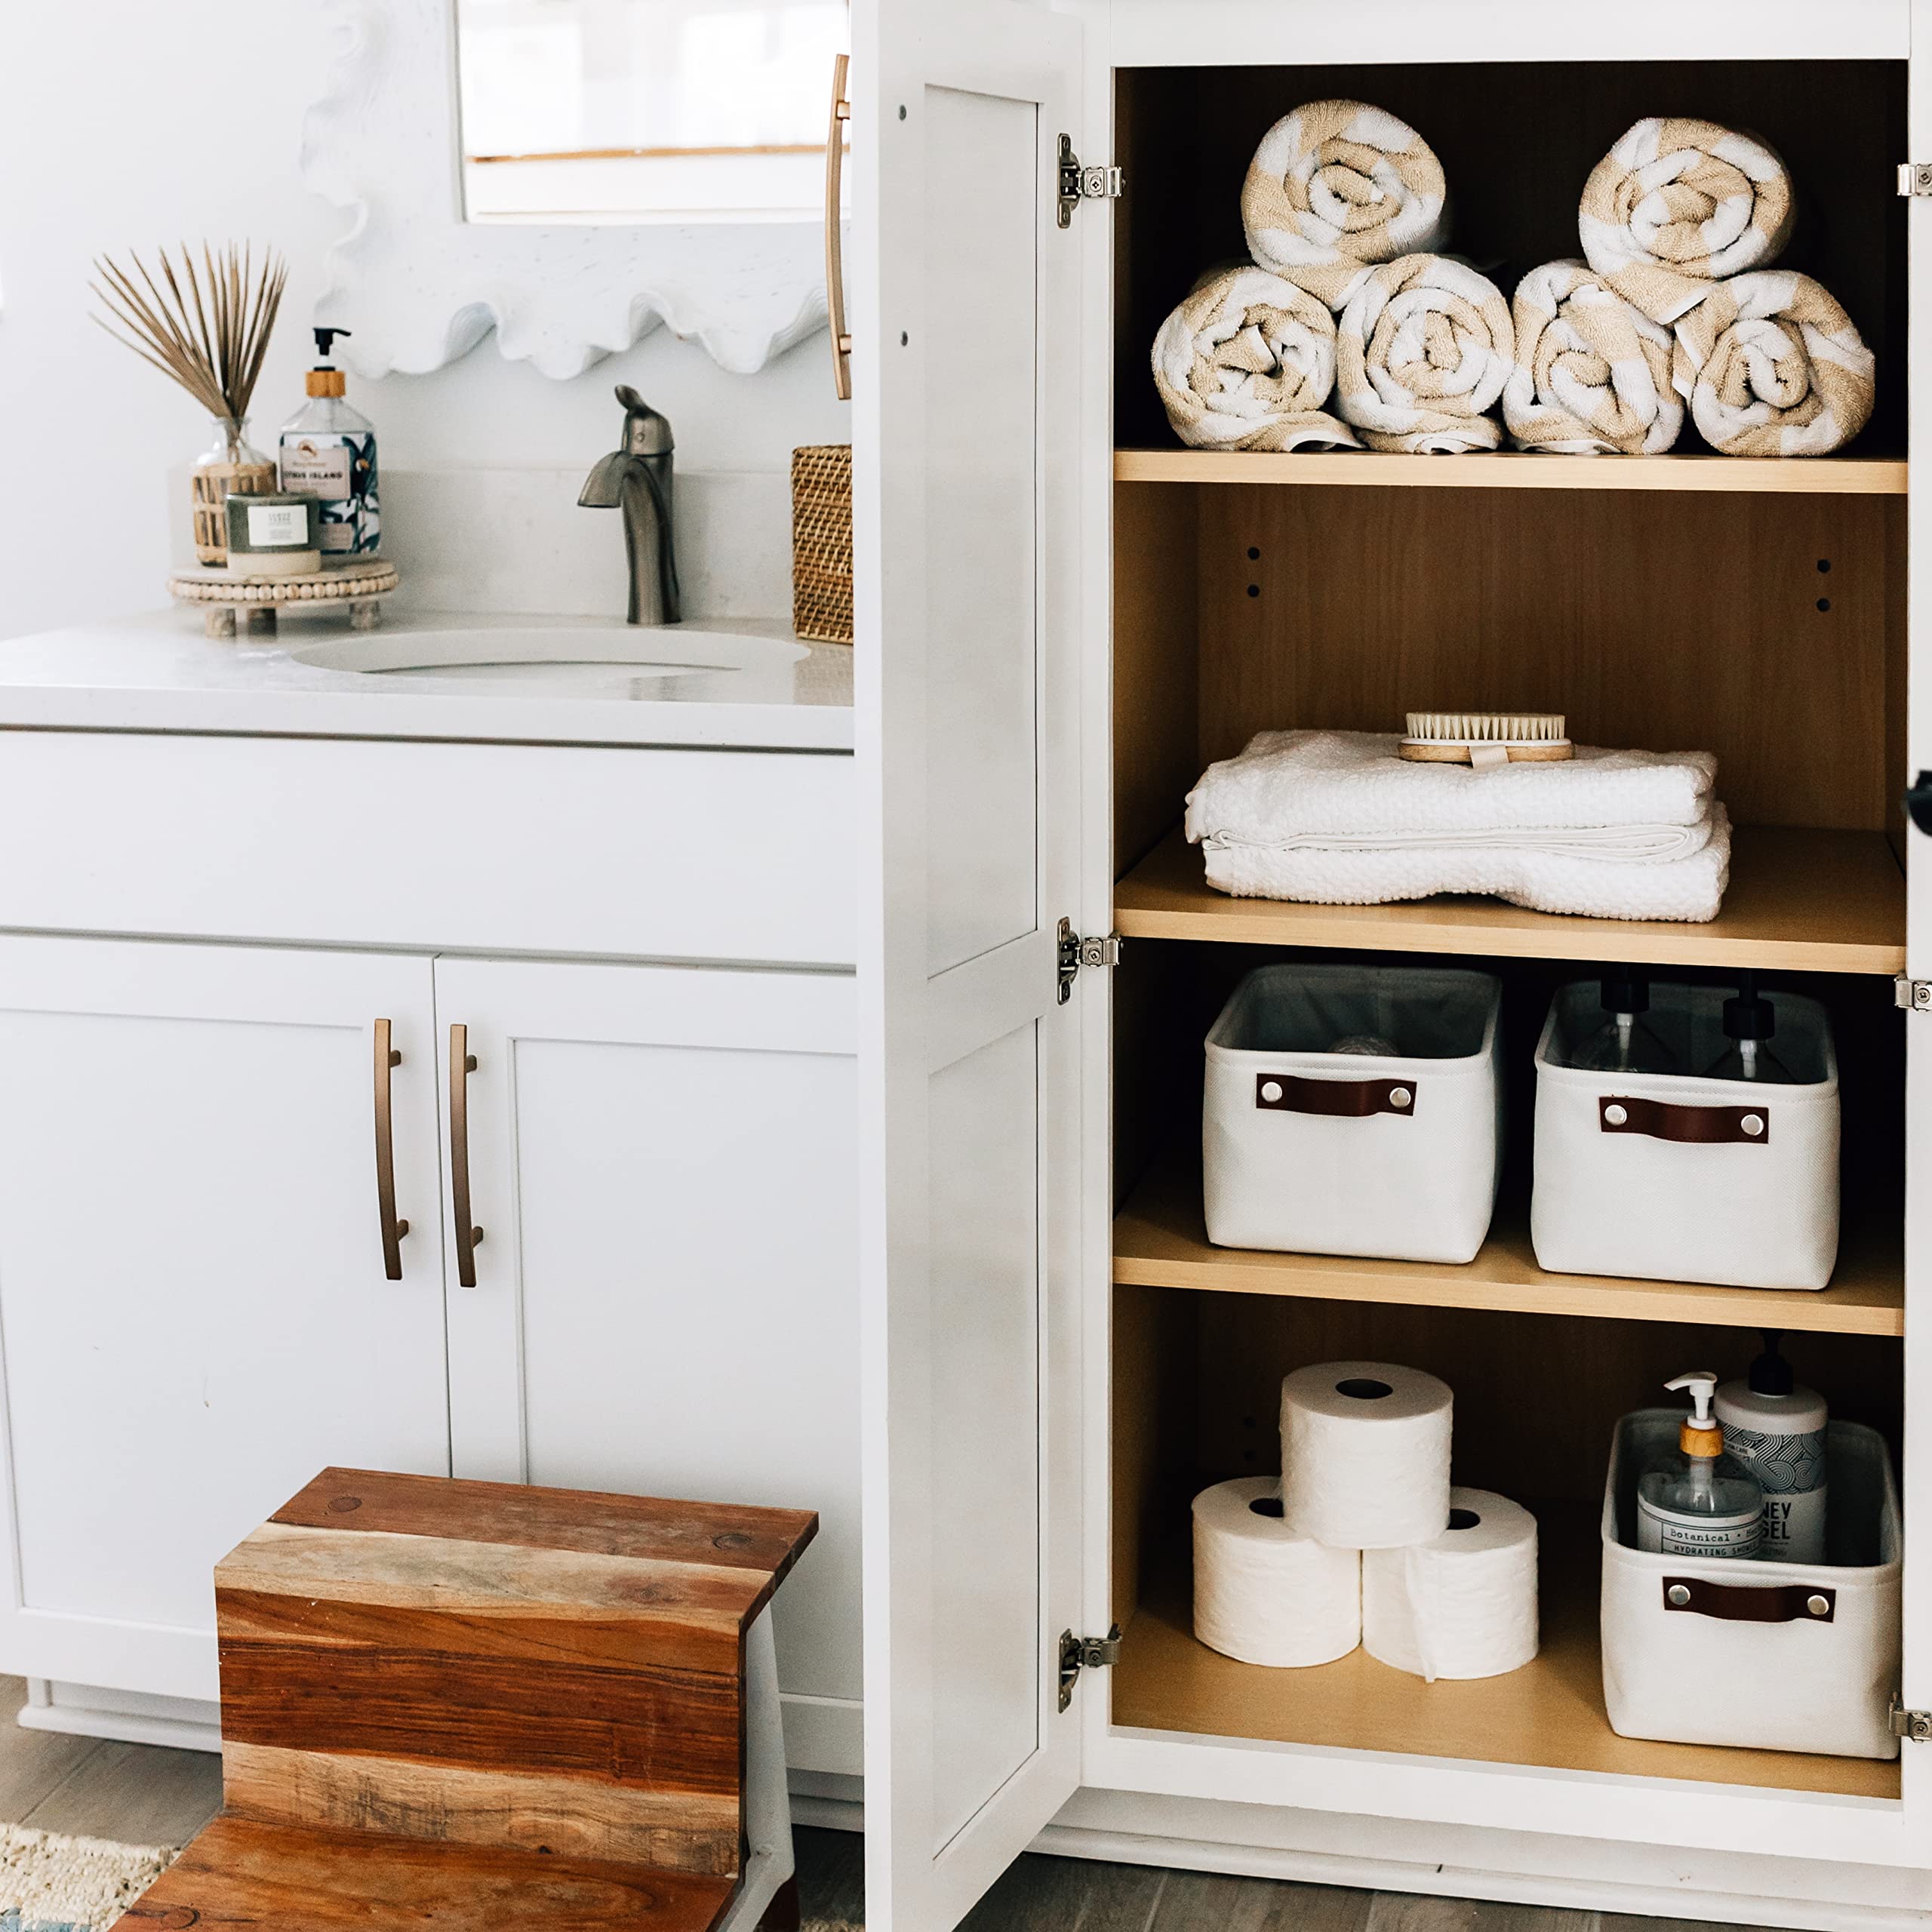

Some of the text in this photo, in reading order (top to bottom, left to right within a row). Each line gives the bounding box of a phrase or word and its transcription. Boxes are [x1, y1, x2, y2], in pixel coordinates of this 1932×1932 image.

[309, 471, 343, 480] ISLAND
[1670, 1528, 1730, 1542] Botanical
[1762, 1520, 1791, 1540] GEL
[1674, 1545, 1727, 1556] HYDRATING
